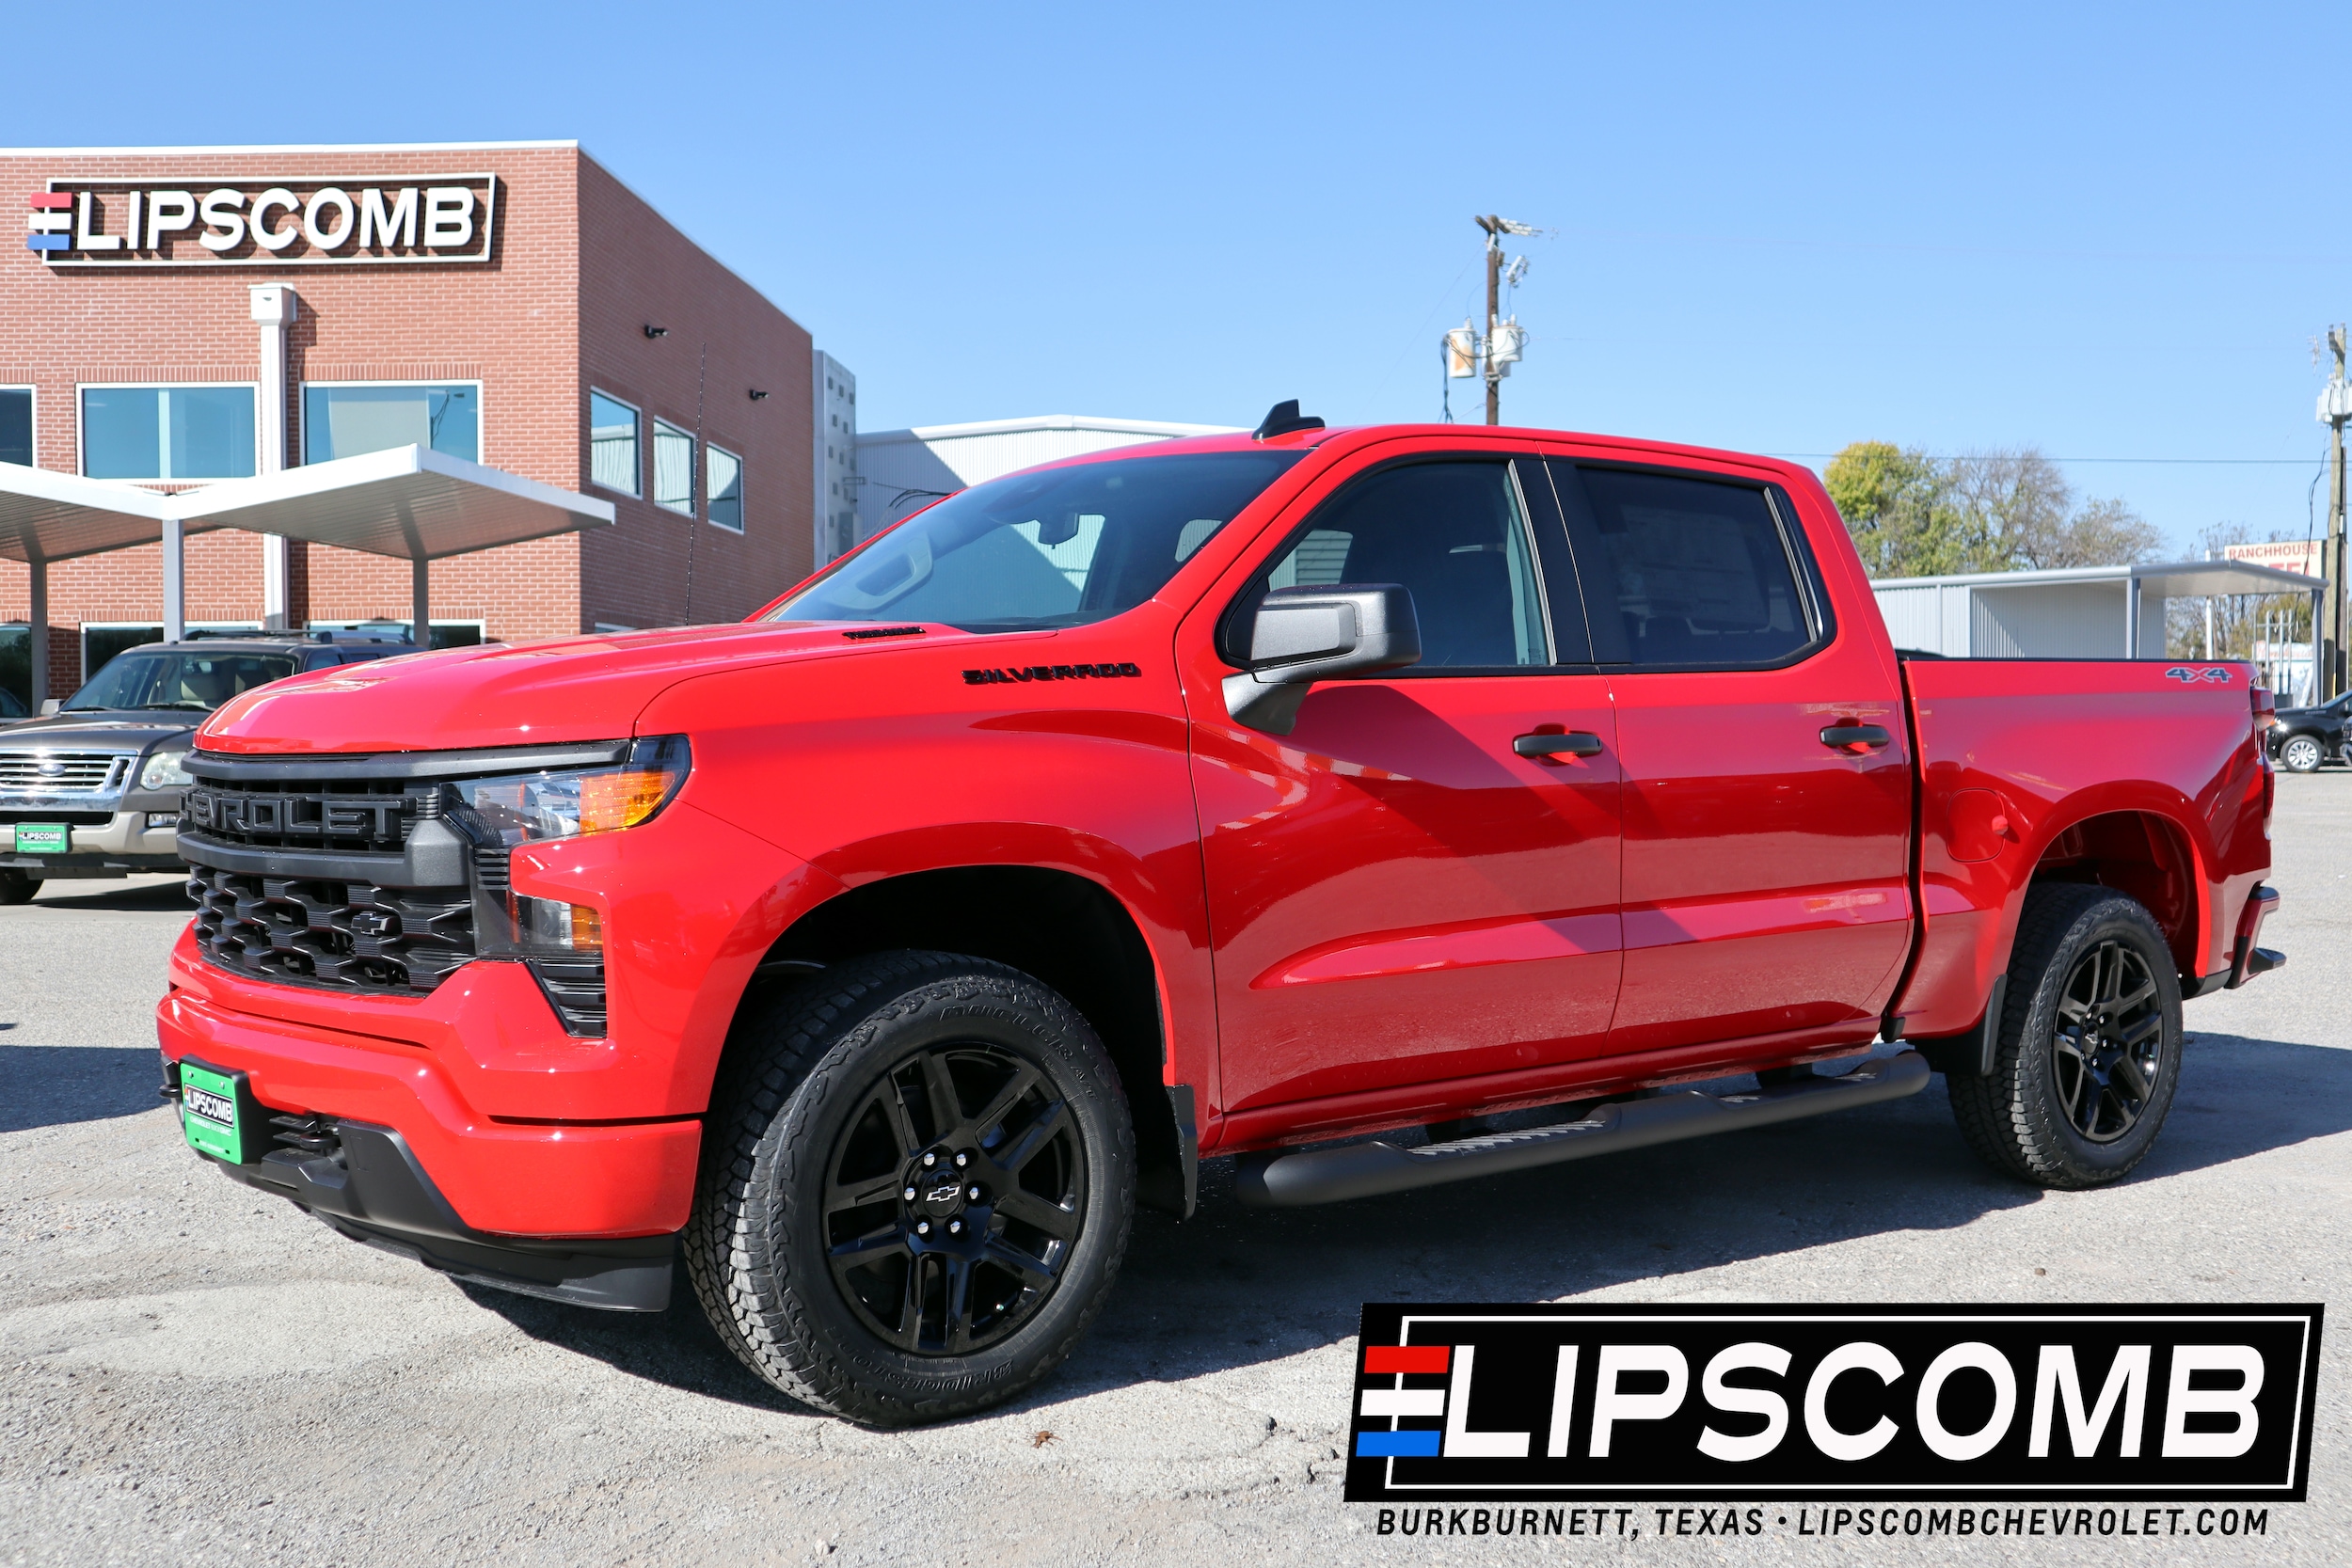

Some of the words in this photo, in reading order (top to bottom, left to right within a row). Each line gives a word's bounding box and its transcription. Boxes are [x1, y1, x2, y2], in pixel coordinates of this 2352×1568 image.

[77, 187, 474, 251] LIPSCOMB
[2229, 543, 2317, 560] RANCHHOUSE
[961, 662, 1138, 685] SILVERADO
[22, 832, 62, 840] LIPSCOMB
[188, 1089, 232, 1122] LIPSCOMB
